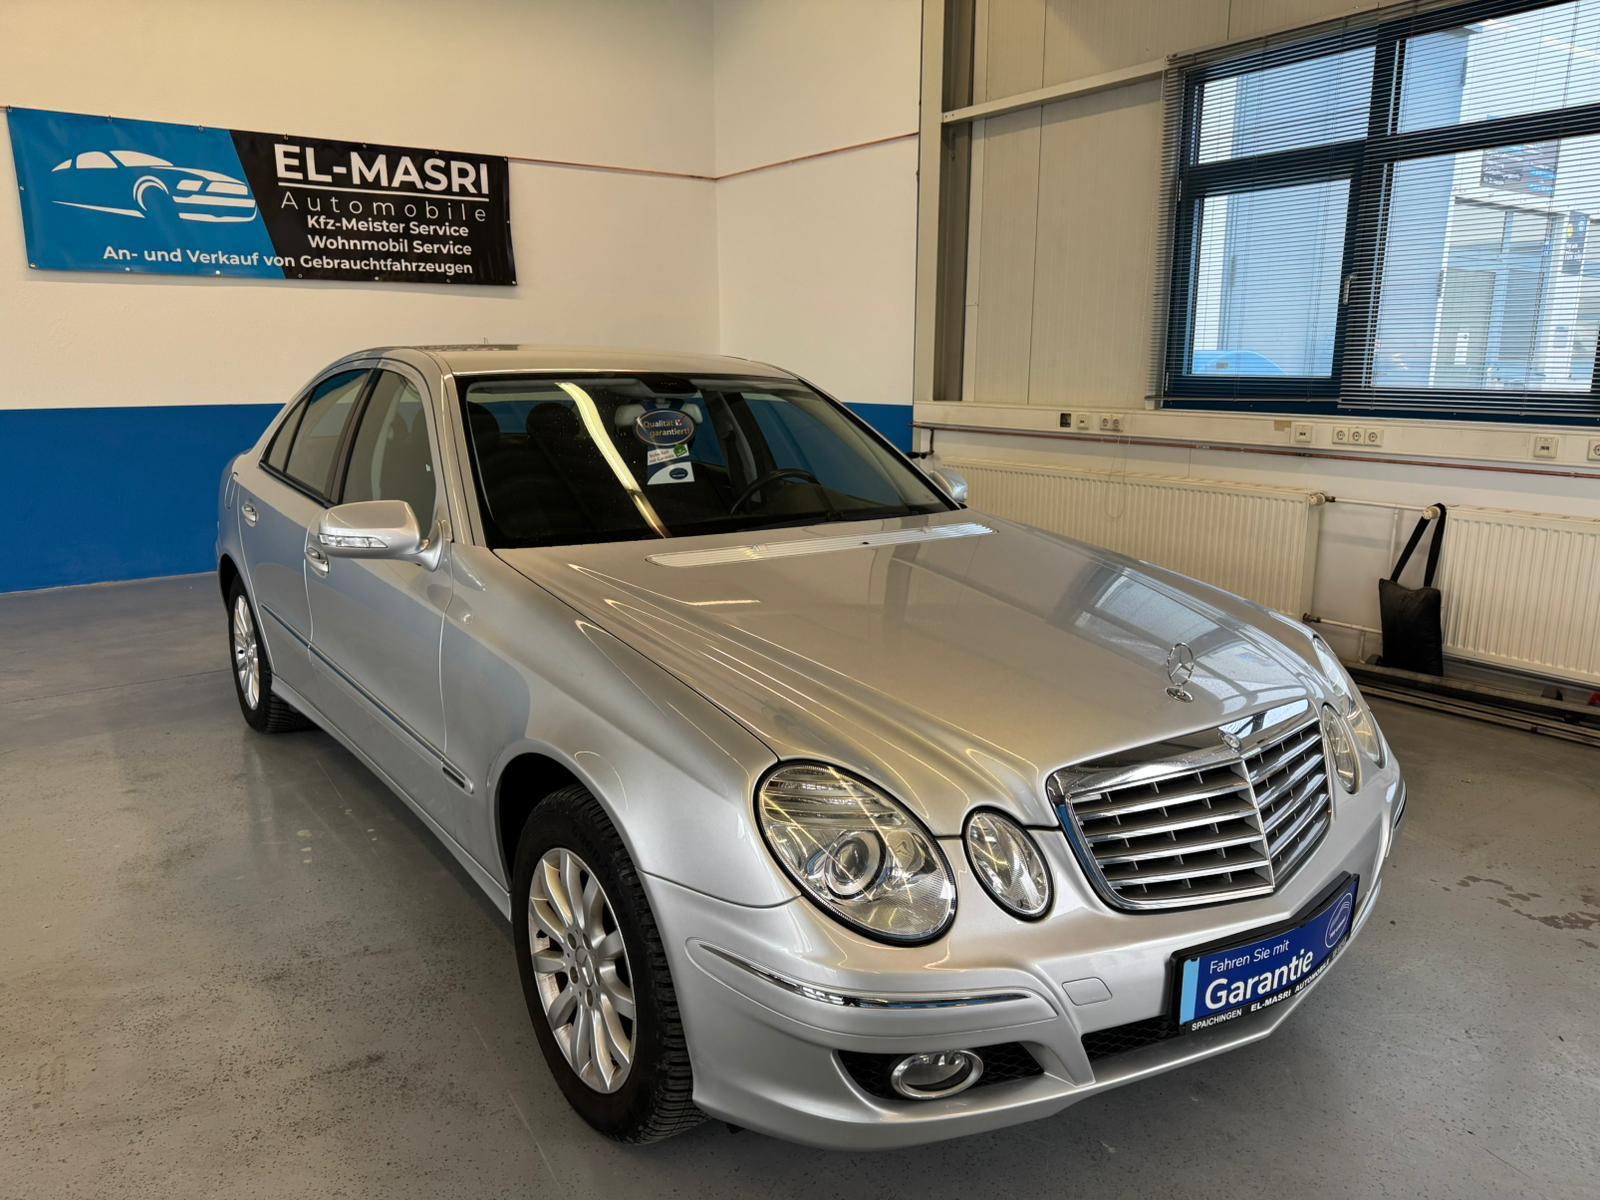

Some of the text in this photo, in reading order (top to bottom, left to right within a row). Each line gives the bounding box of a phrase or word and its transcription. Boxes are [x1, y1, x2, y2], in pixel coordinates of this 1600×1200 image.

[274, 143, 489, 194] EL-MASRI
[281, 191, 486, 222] Automobile
[307, 214, 469, 236] Kfz-Meister Service
[103, 246, 473, 276] An- und Verkauf von Gebrauchtfahrzeugen
[307, 235, 472, 255] Wohnmobil Service
[1209, 939, 1290, 975] Fahren Sie mit
[1204, 948, 1314, 1010] Garantie
[1191, 1008, 1242, 1031] SPAICHINGEN
[1250, 990, 1291, 1012] EL-MASRI
